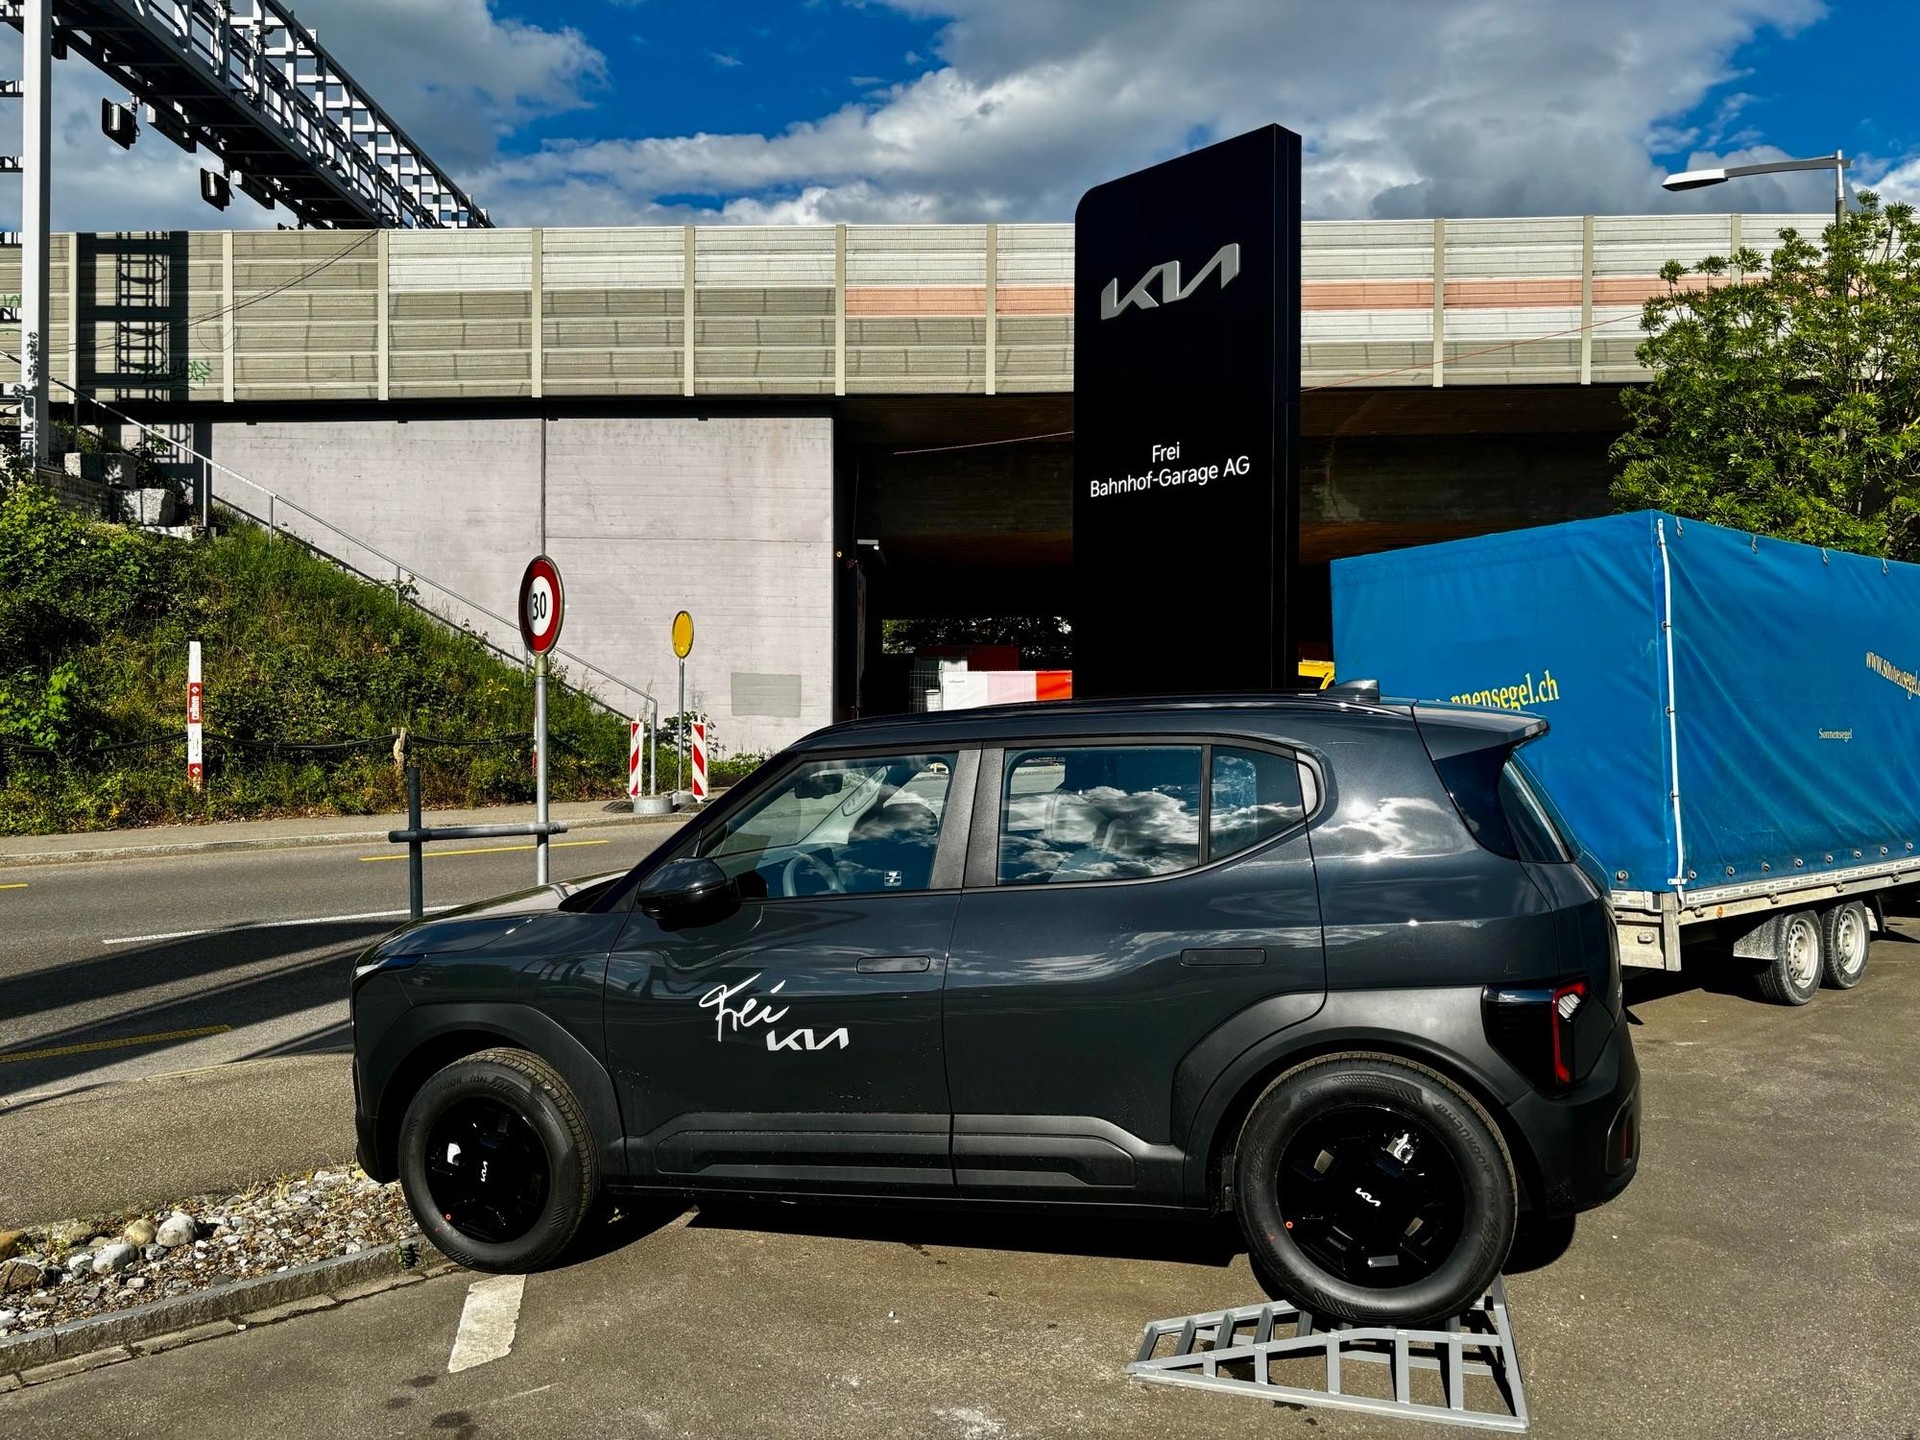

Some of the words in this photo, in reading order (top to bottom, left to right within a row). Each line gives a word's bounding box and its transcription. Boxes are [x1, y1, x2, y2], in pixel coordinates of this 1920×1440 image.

[1152, 441, 1180, 463] Frei
[1090, 464, 1218, 497] Bahnhof-Garage
[1223, 455, 1250, 478] AG
[532, 591, 547, 621] 30
[1450, 669, 1560, 711] nnensegel.ch
[1819, 728, 1852, 742] Sonnensegel
[699, 972, 790, 1042] Frei
